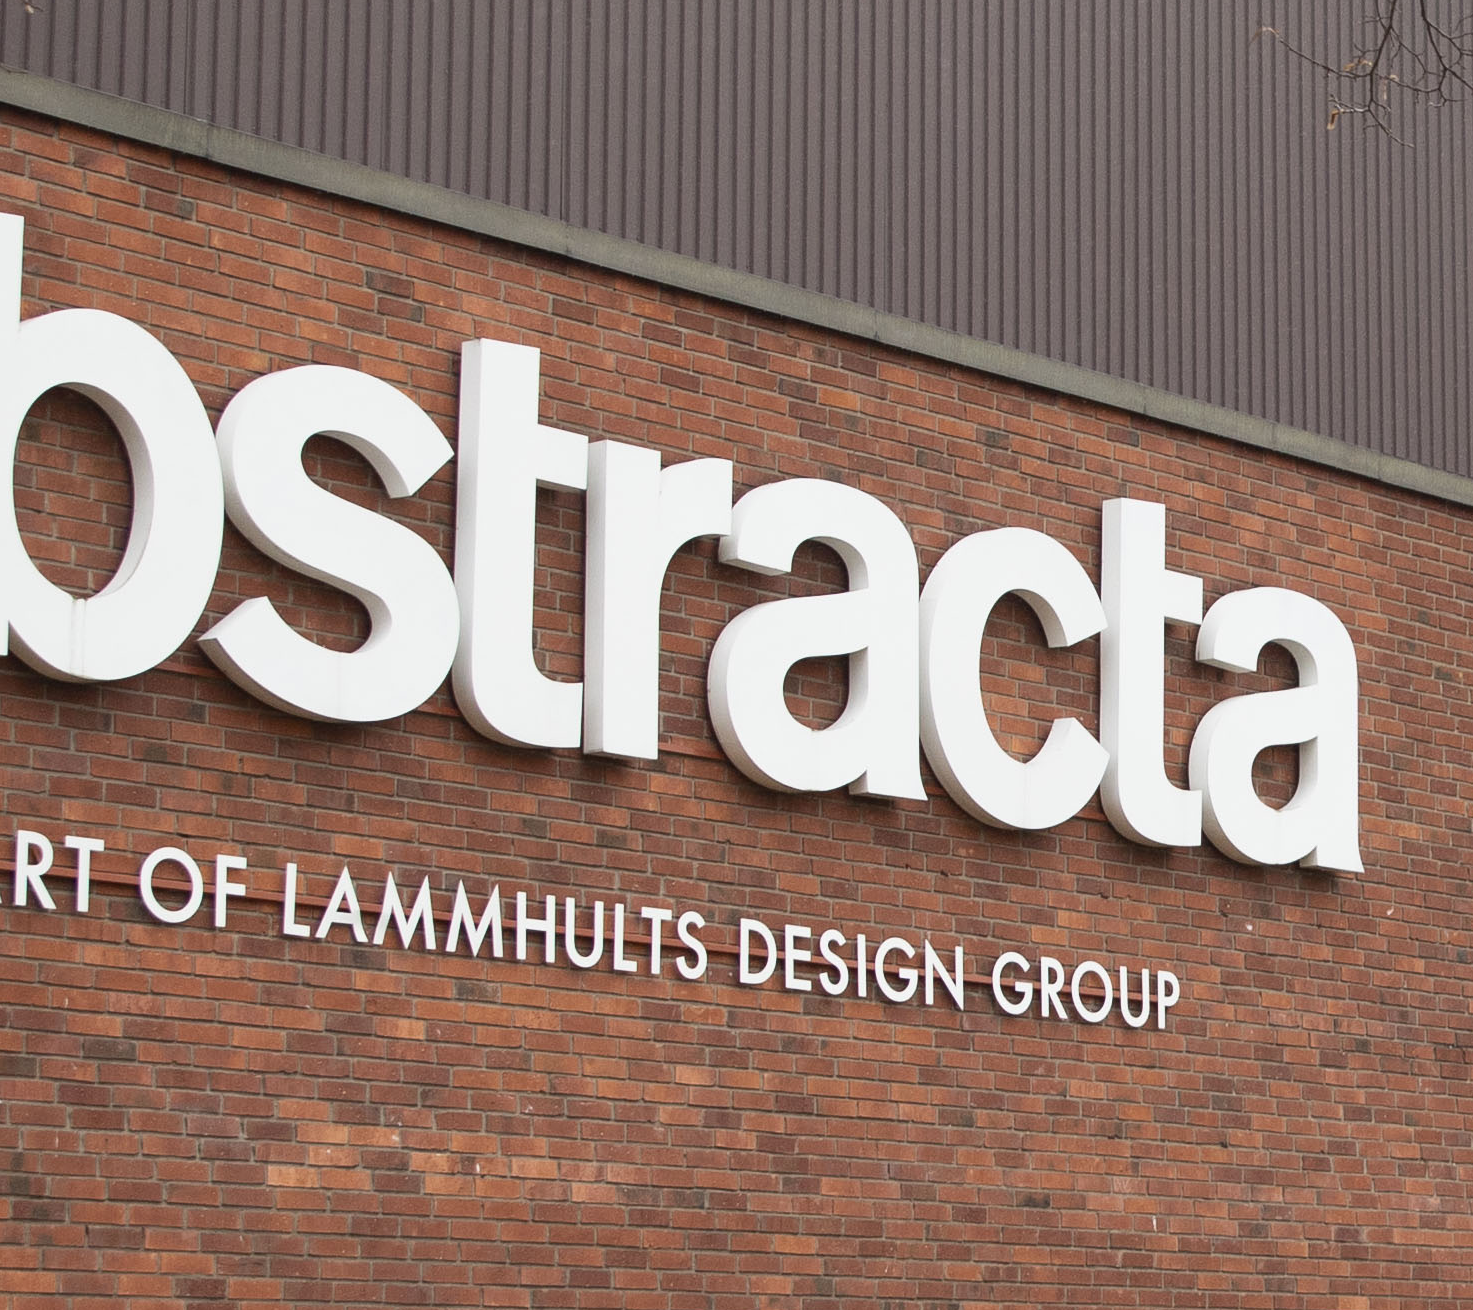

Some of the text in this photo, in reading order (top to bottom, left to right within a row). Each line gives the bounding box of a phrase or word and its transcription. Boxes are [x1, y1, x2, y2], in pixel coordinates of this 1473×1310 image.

[138, 846, 248, 928] OF
[282, 861, 709, 982] LAMMHULTS
[738, 917, 966, 1012] DESIGN
[990, 951, 1182, 1030] GROUP
